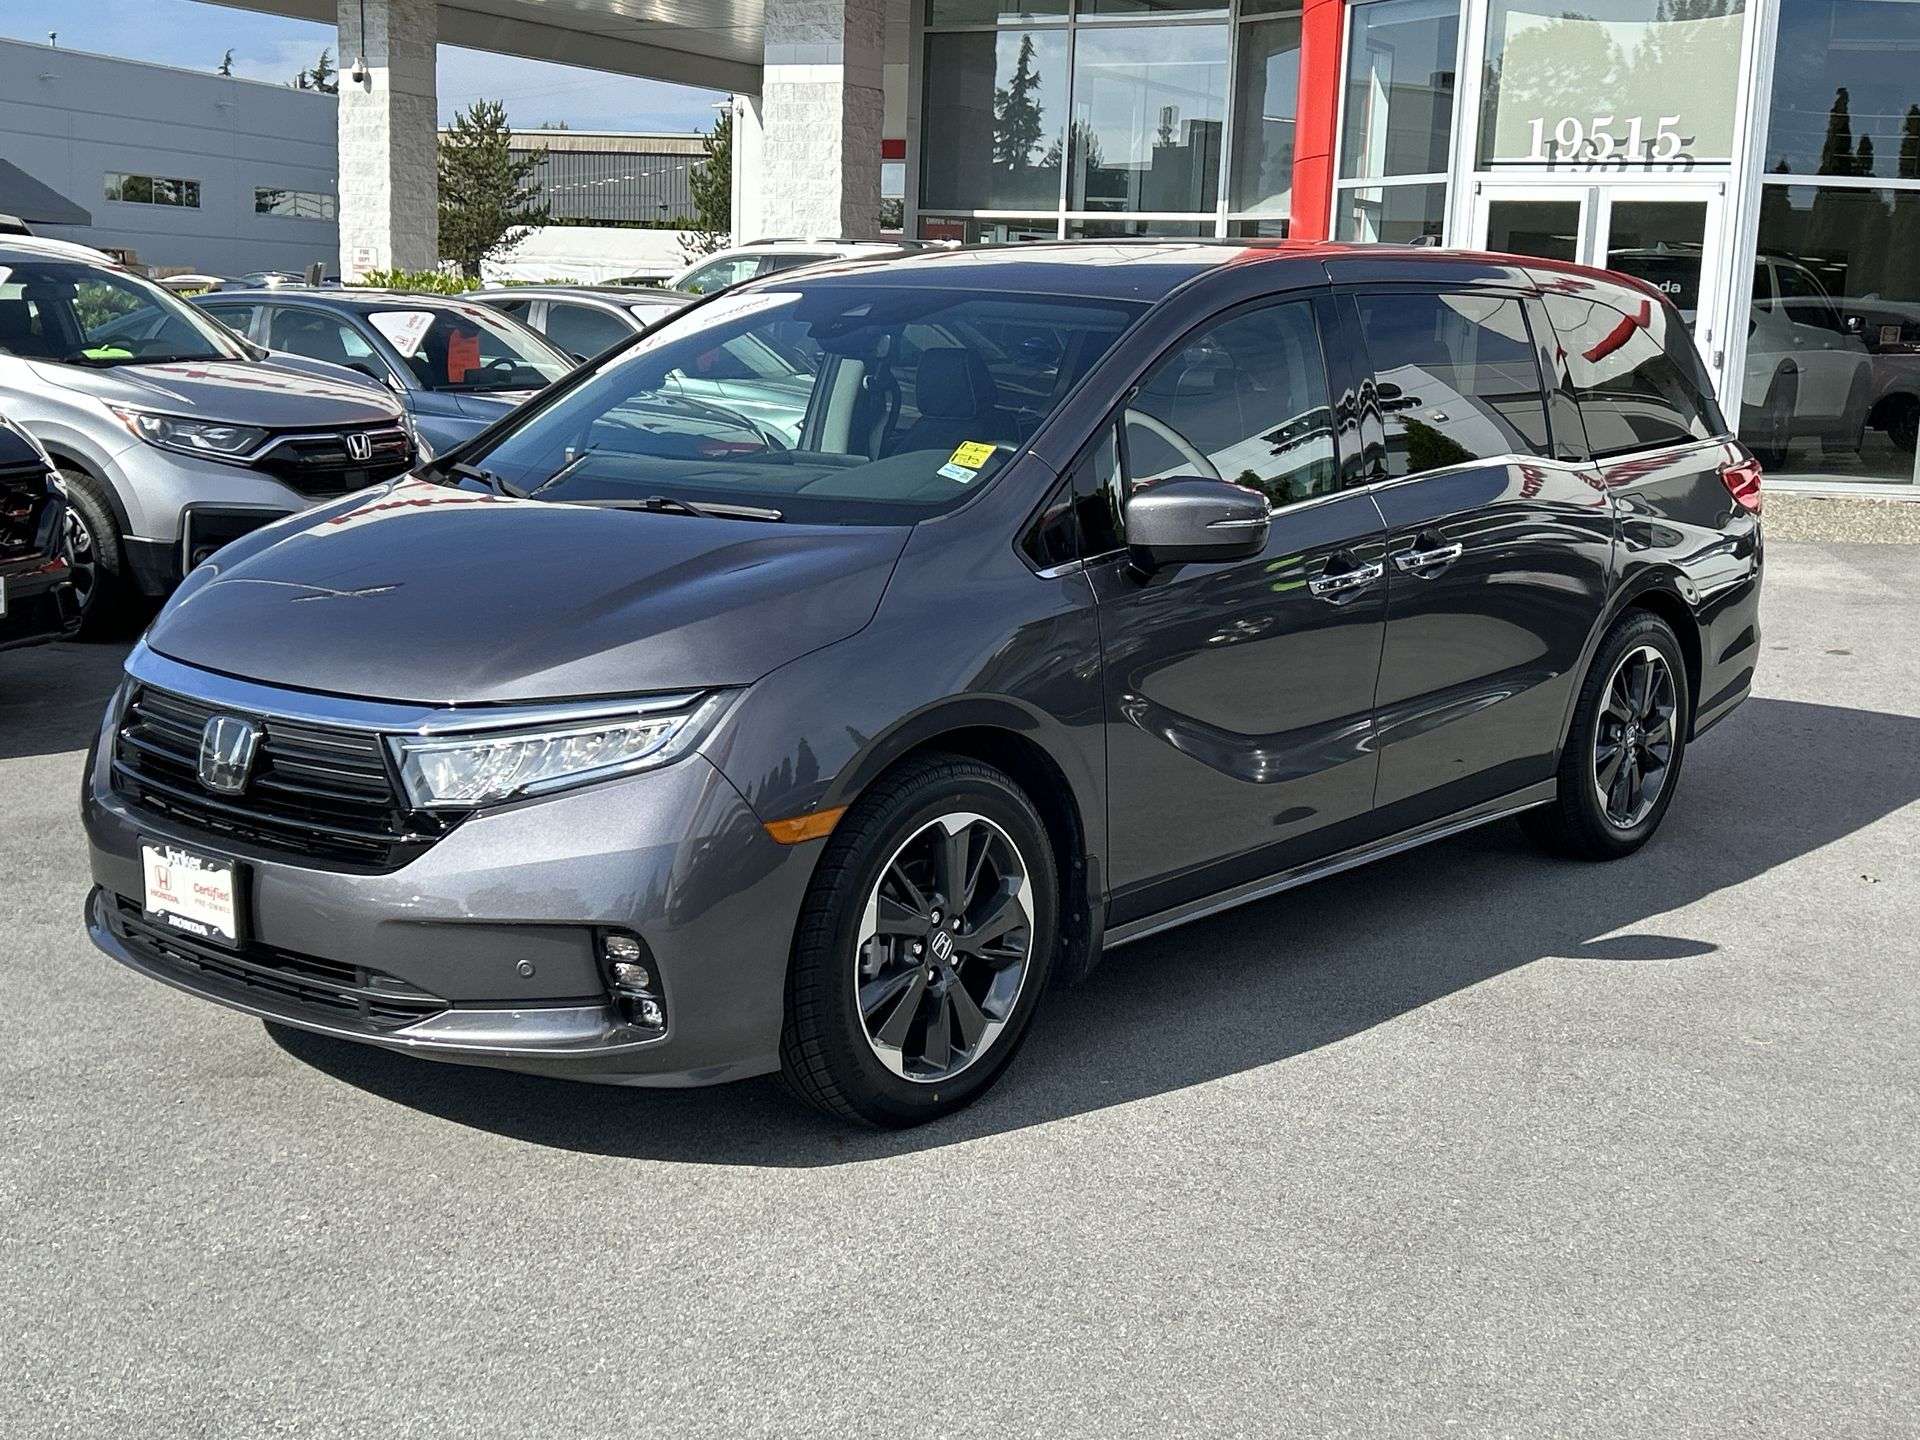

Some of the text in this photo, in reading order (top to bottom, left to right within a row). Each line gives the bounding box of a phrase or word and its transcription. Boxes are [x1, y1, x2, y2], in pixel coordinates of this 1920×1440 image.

[1525, 115, 1681, 161] 19515
[150, 889, 180, 904] HONDA
[193, 883, 230, 902] Certified
[167, 914, 209, 936] HONDA
